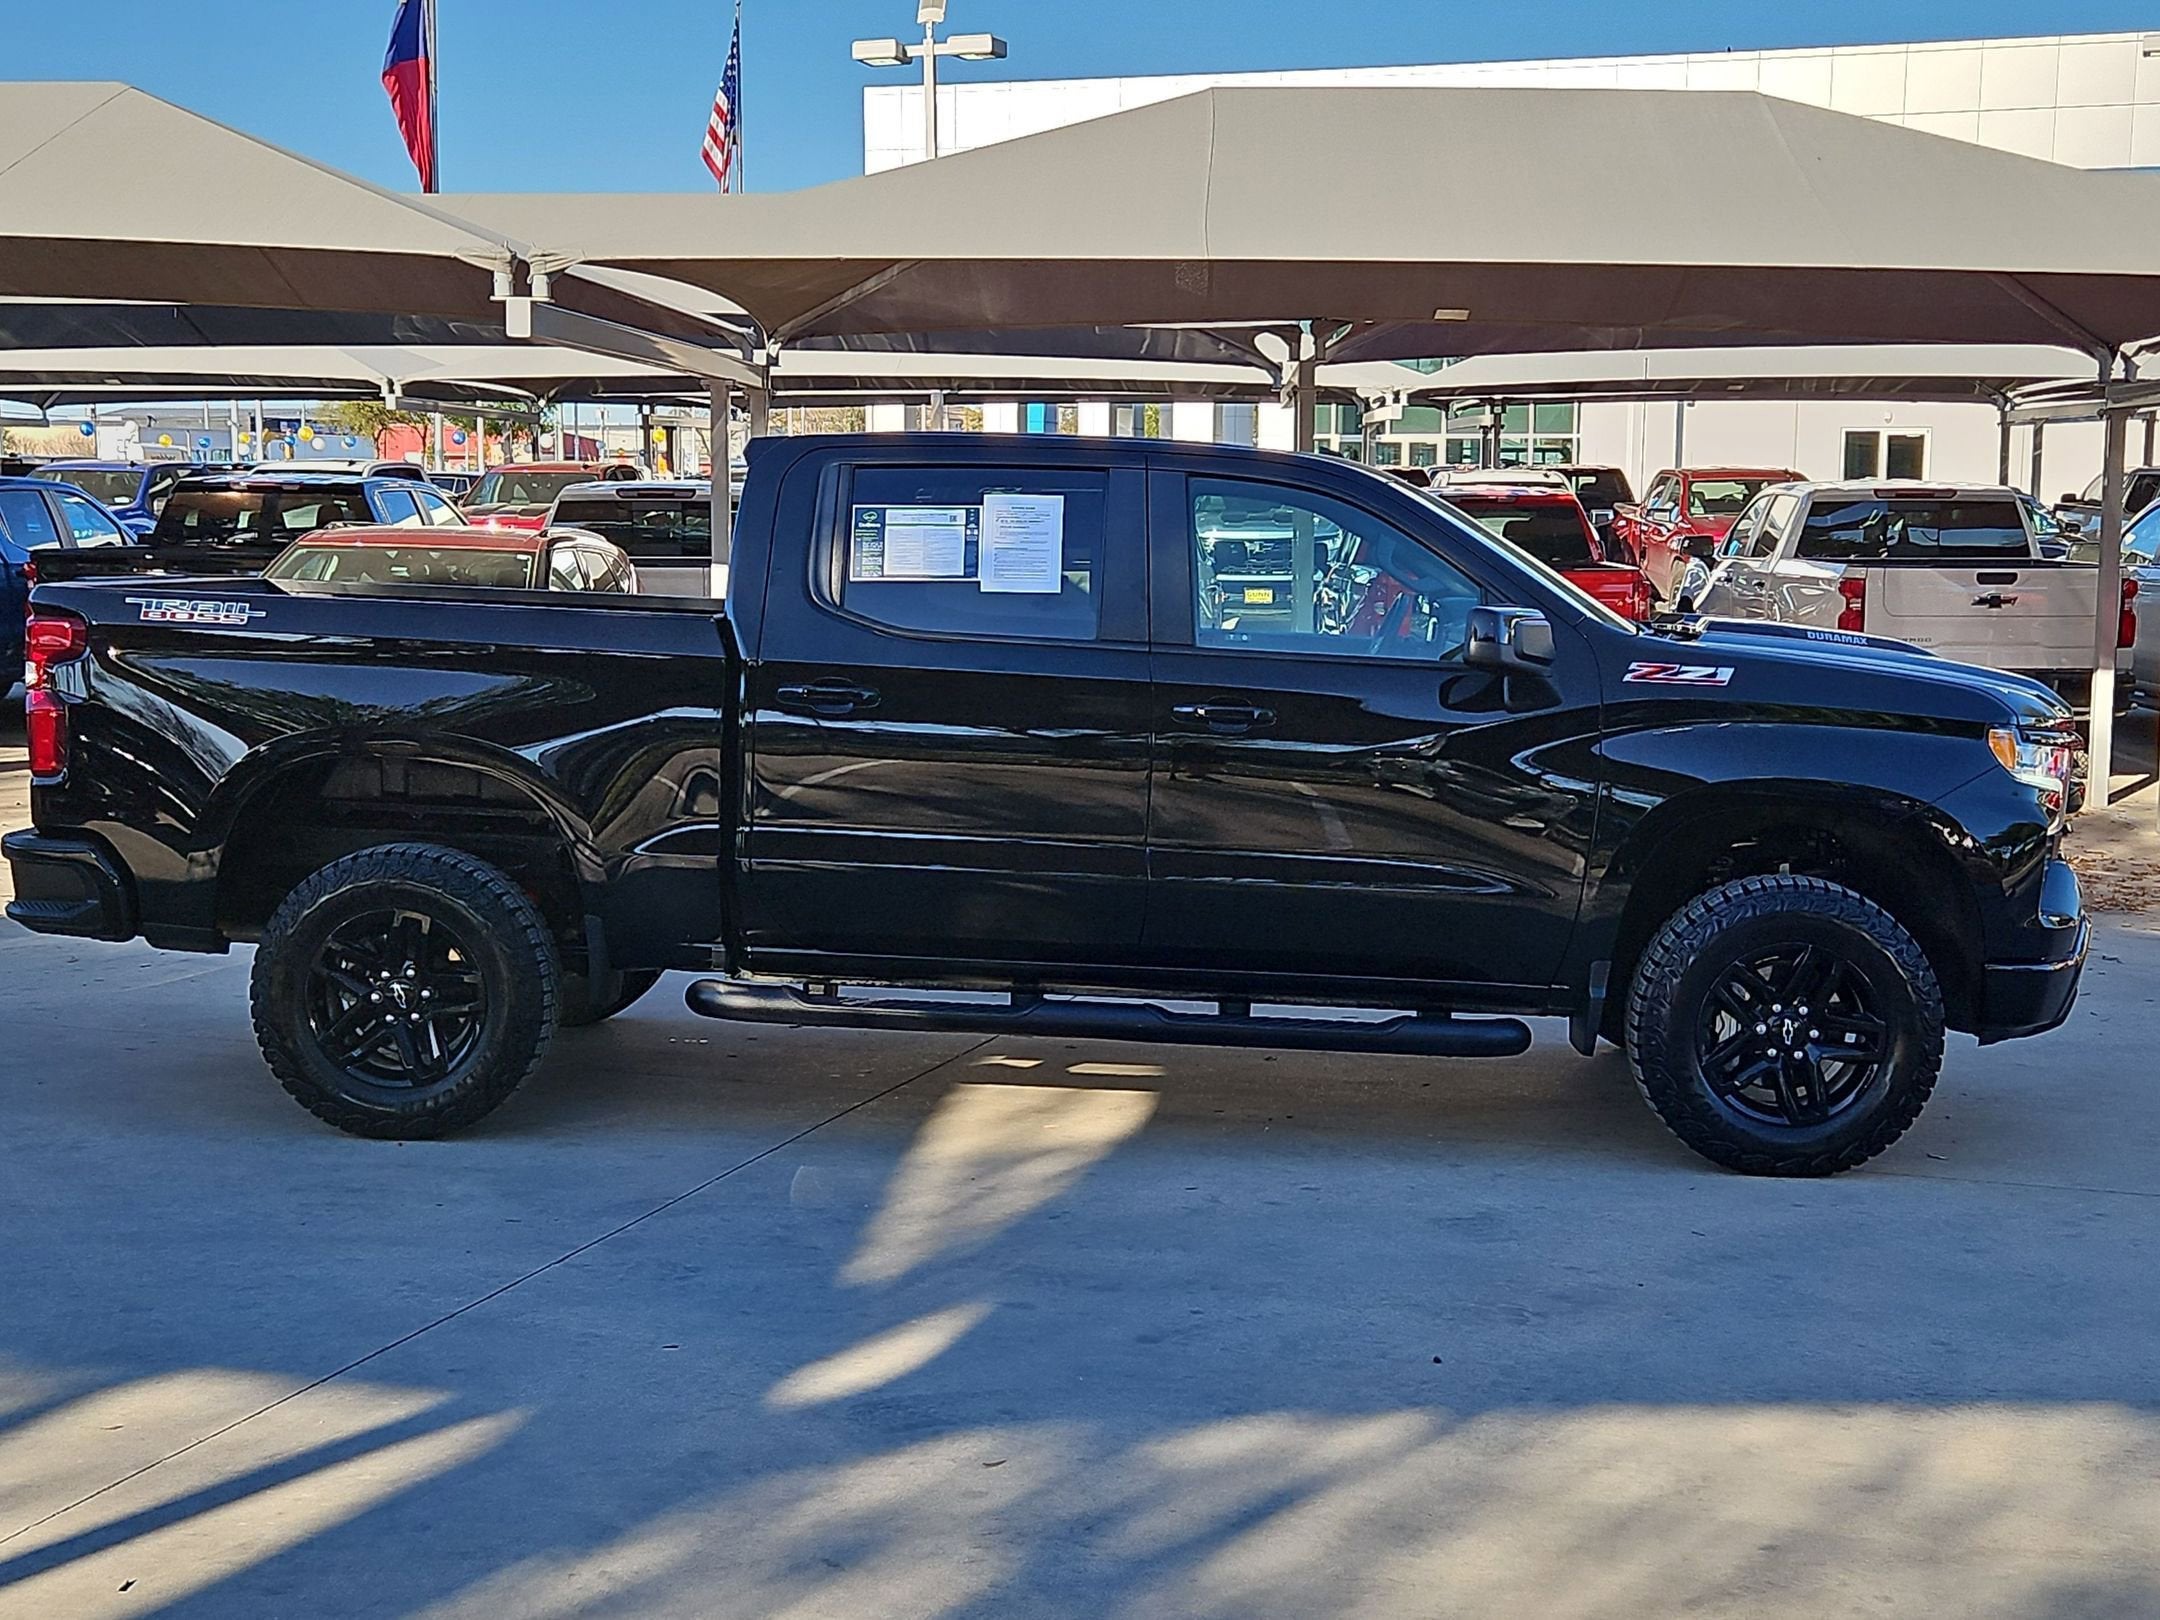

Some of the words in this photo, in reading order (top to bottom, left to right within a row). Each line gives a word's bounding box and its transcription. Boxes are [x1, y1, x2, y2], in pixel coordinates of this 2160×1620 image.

[125, 597, 267, 617] TRAIL
[139, 609, 249, 625] BOSS
[1806, 631, 1869, 645] DURAMAX
[1622, 661, 1736, 687] Z71
